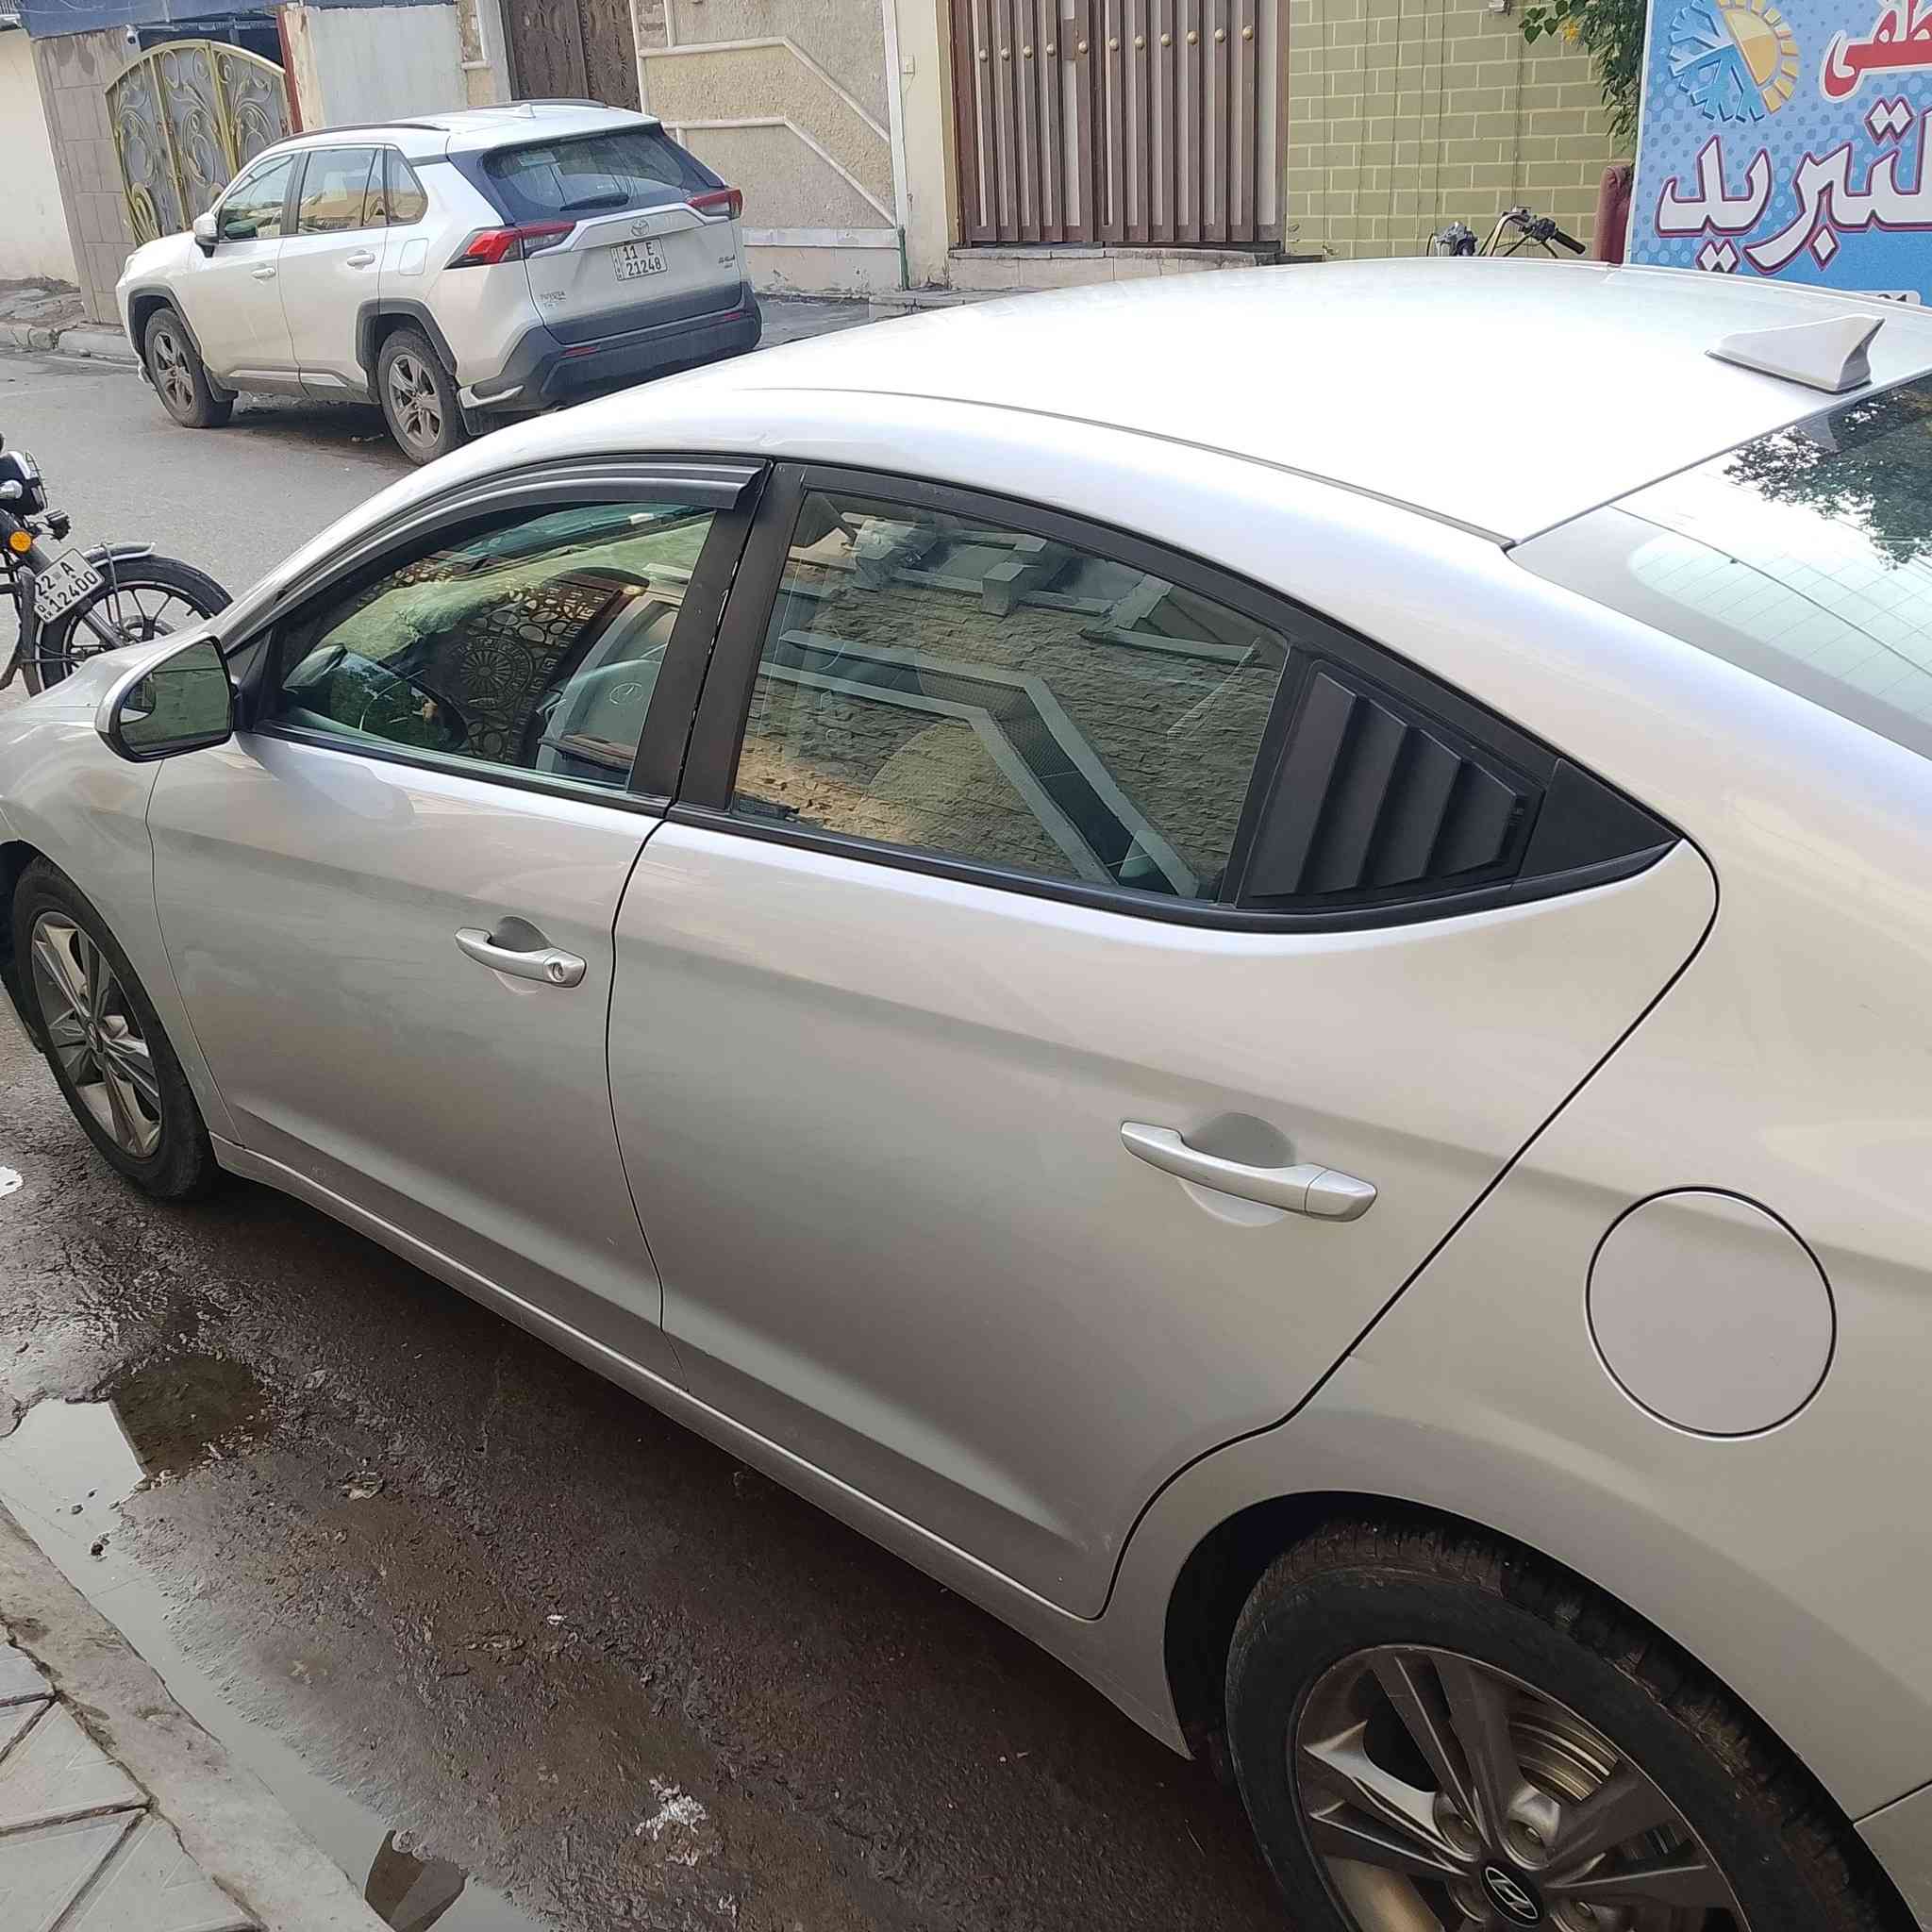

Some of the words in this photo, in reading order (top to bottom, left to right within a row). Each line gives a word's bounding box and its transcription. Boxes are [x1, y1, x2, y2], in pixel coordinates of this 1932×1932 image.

[623, 245, 638, 260] 11
[645, 242, 655, 256] E
[625, 257, 661, 275] 21248
[35, 575, 57, 596] 22
[60, 561, 75, 576] A
[49, 570, 98, 612] 12400
